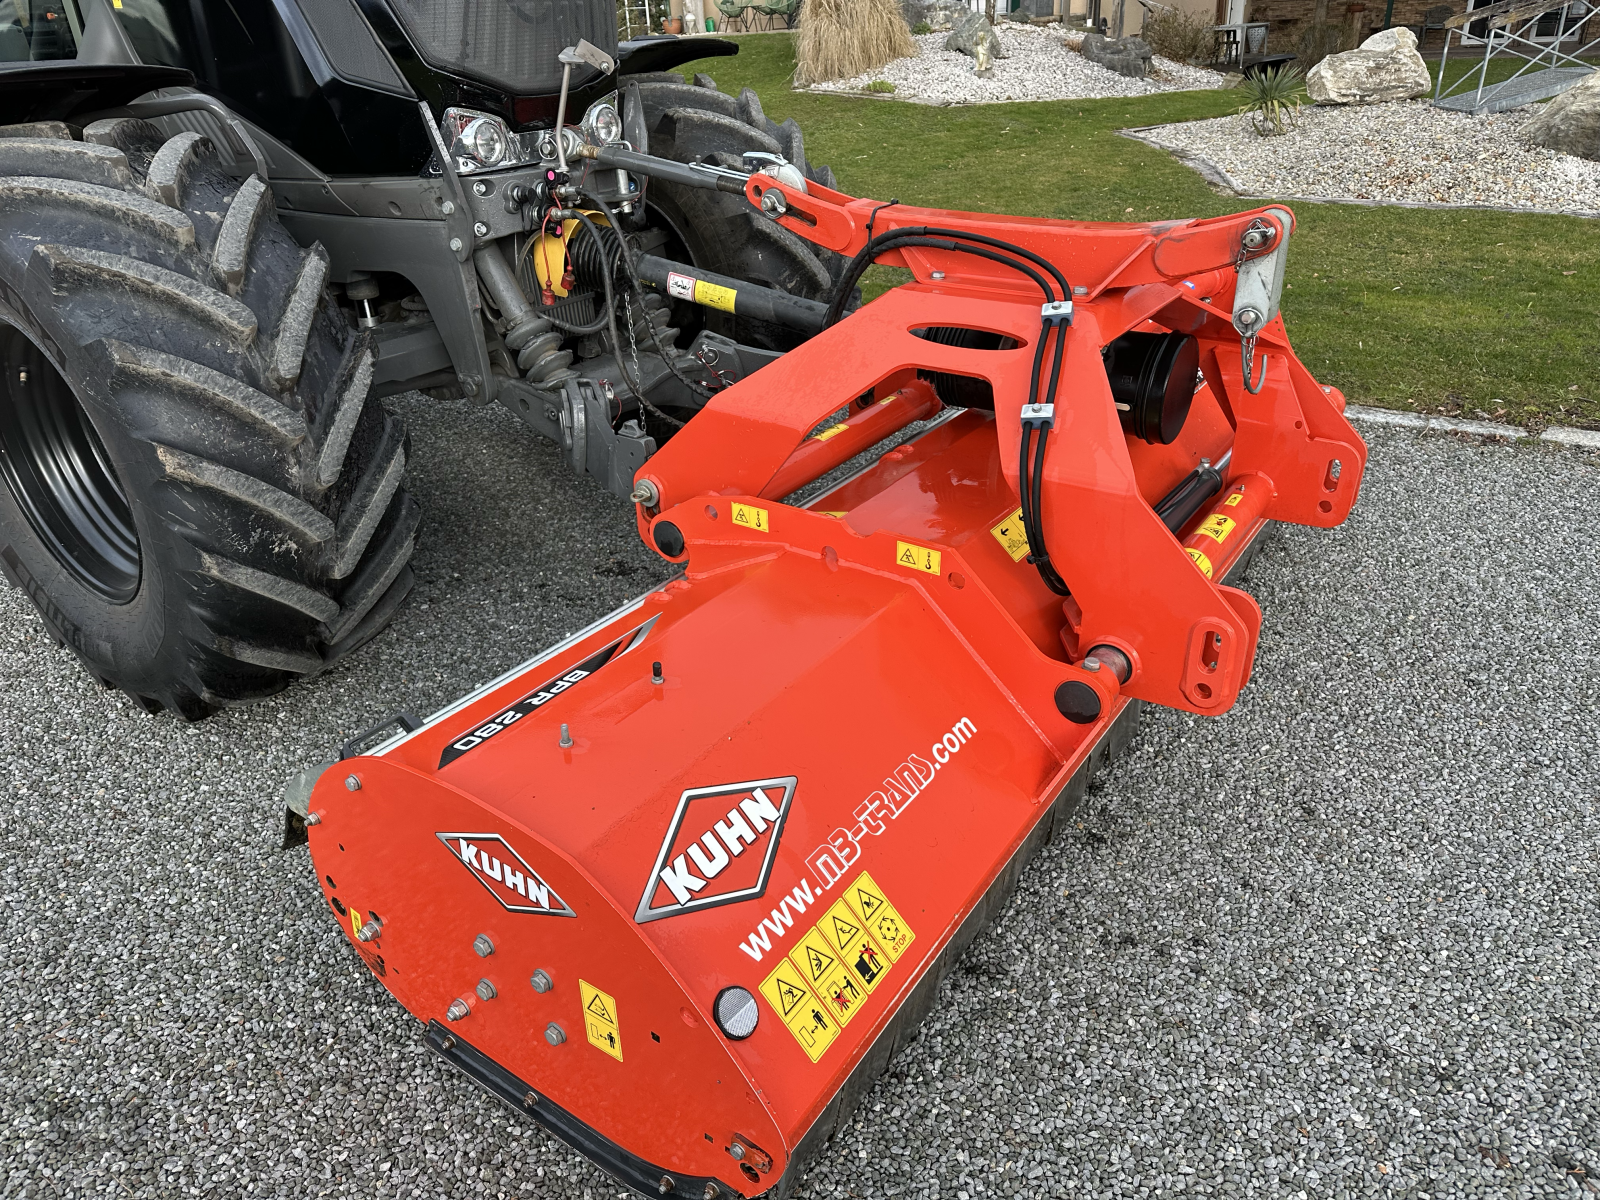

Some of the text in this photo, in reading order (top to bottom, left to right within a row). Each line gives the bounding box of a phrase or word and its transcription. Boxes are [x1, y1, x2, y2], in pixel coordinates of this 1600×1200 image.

[452, 669, 591, 751] BPR 280
[458, 838, 550, 911] KUHN
[659, 787, 781, 906] KUHN
[892, 933, 907, 954] STOP
